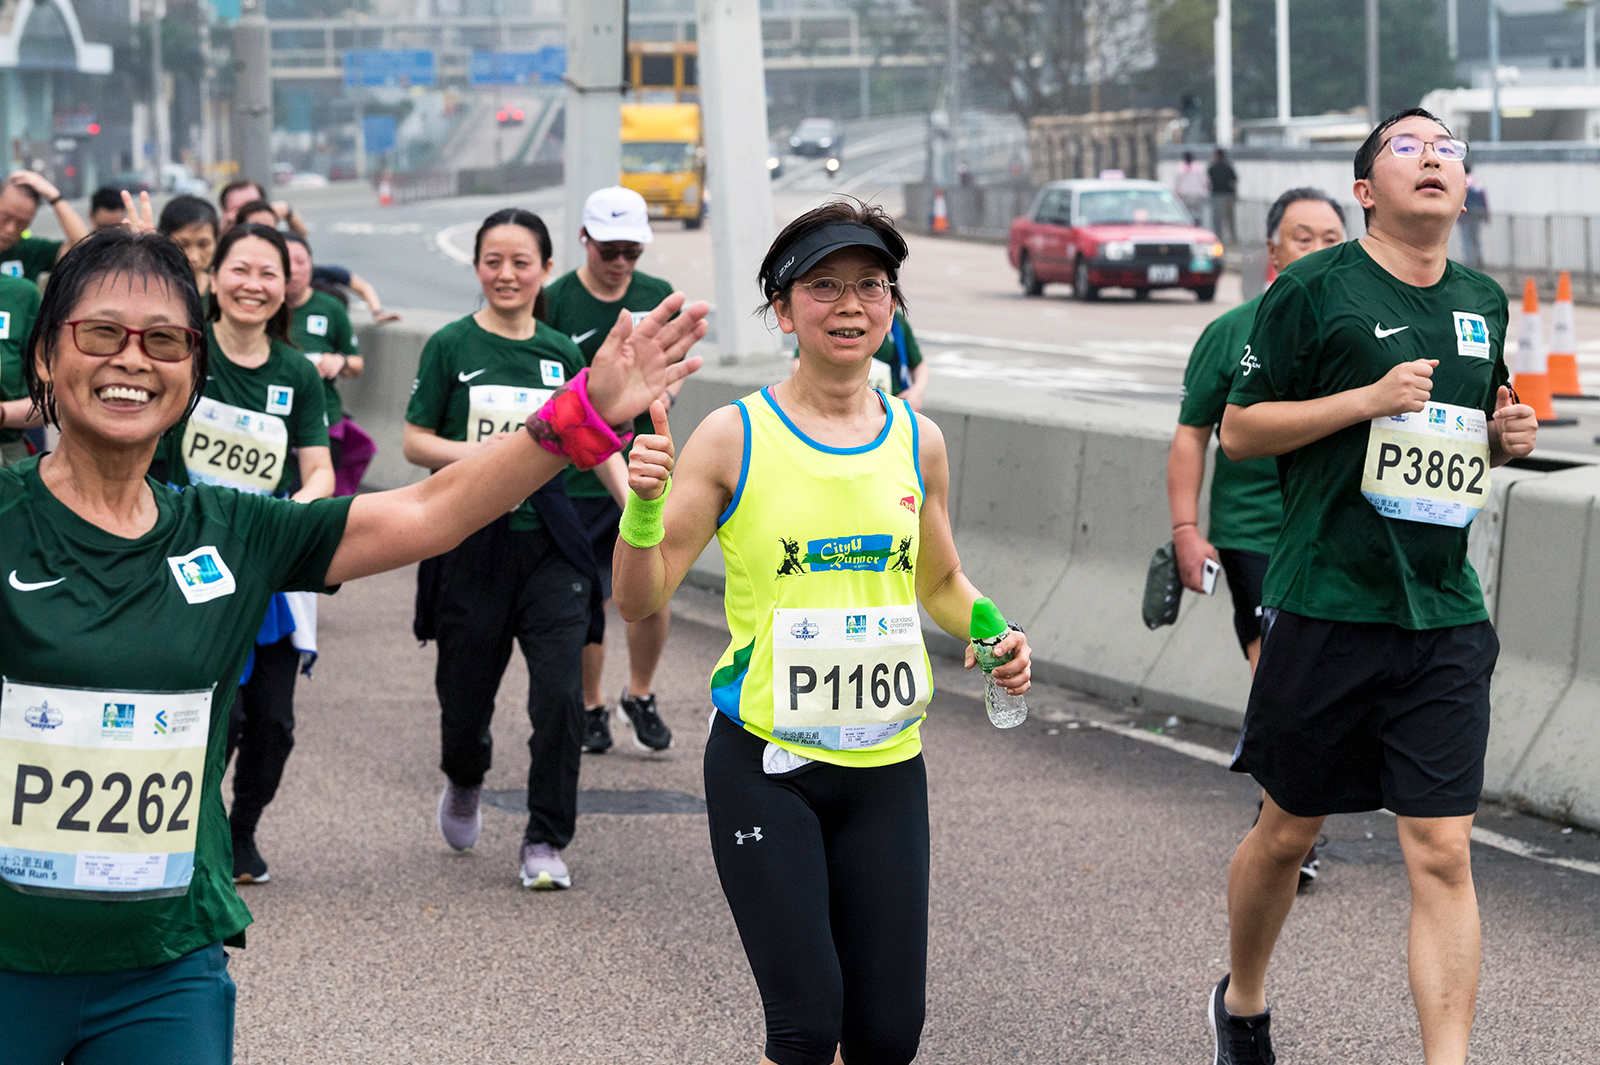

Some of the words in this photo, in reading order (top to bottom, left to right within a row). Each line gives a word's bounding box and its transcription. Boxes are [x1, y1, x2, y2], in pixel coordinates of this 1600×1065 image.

[189, 432, 277, 480] P2692
[1376, 442, 1485, 495] P3862
[820, 537, 862, 561] CityU
[829, 555, 880, 569] Runner
[789, 661, 916, 711] P1160
[12, 763, 194, 834] P2262
[0, 866, 26, 877] 10KM
[28, 870, 49, 879] Run
[51, 871, 58, 880] 5
[1, 854, 54, 870] 十公里五組
